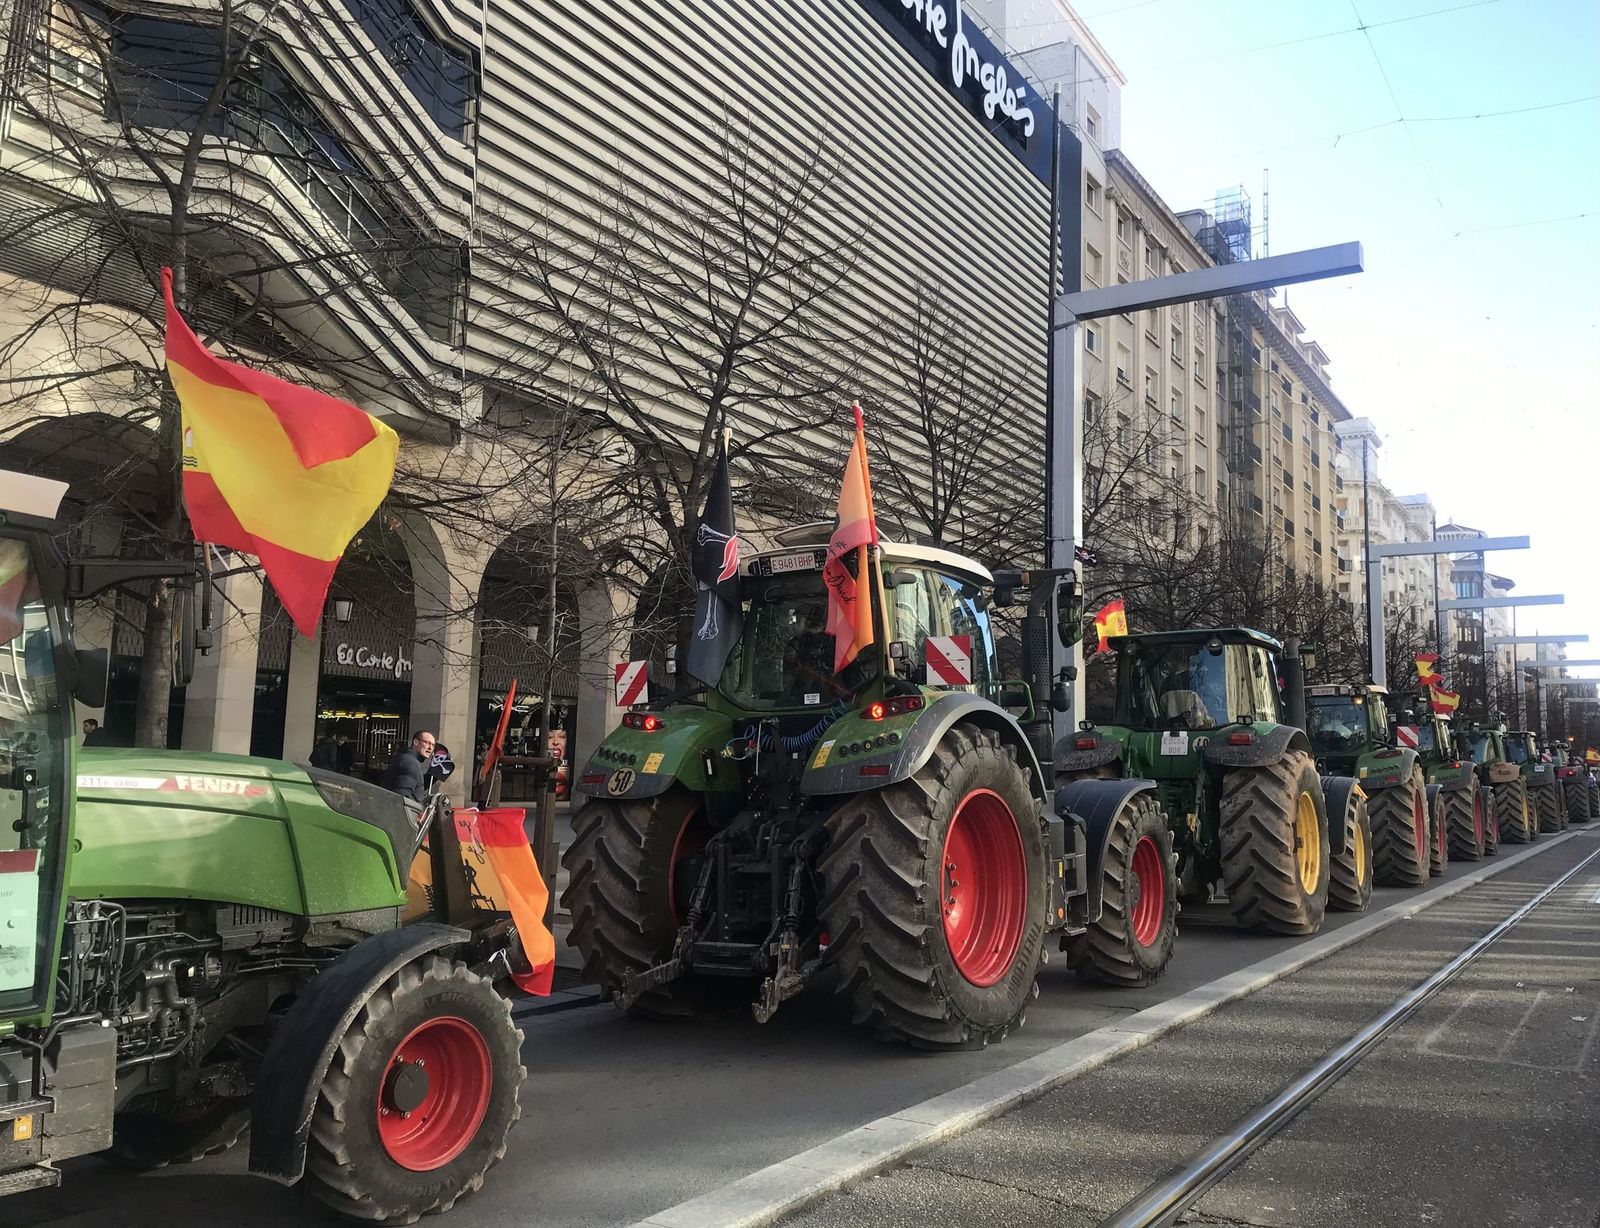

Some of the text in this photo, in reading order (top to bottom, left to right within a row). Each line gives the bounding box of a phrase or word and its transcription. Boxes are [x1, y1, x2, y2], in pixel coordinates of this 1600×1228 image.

[952, 0, 1034, 137] Inglés
[336, 643, 354, 666] El
[355, 646, 394, 670] Corte
[80, 777, 101, 787] 211
[174, 775, 251, 795] FENDT
[610, 770, 633, 793] 50
